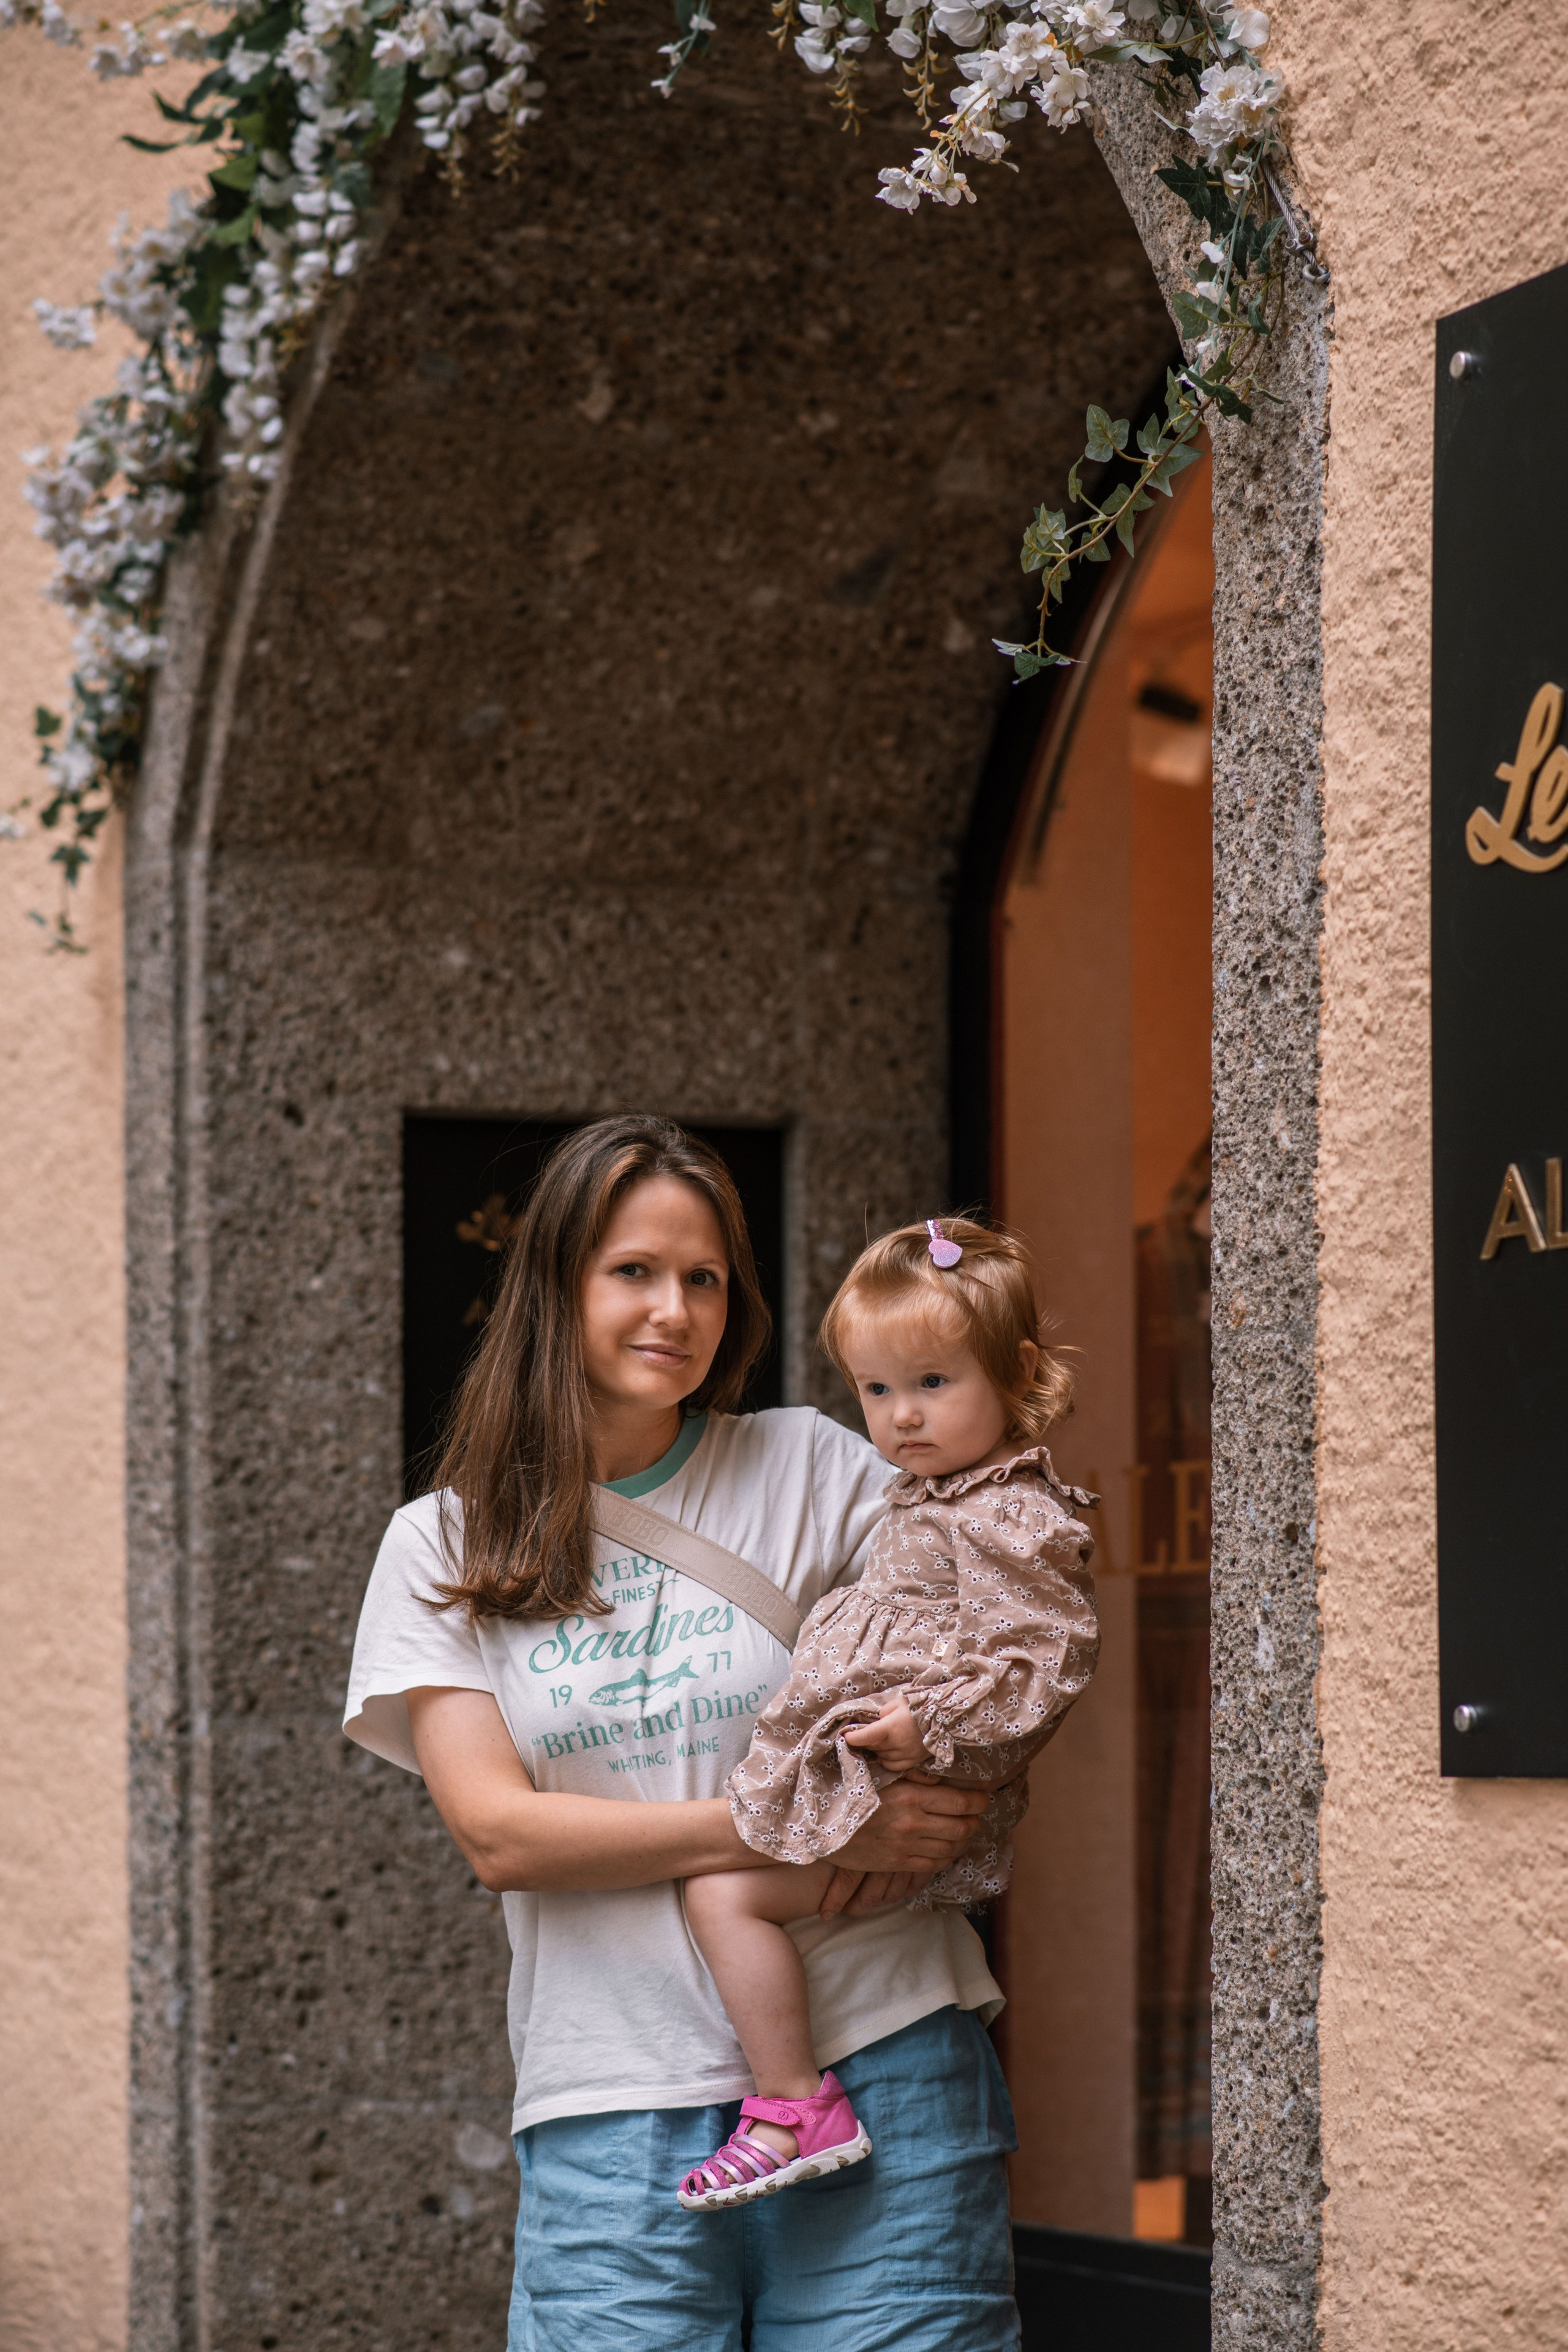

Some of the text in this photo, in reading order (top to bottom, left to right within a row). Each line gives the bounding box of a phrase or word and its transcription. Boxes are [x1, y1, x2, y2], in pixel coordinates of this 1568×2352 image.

[1479, 1156, 1568, 1261] AL
[529, 1603, 734, 1673] Sardines
[549, 1650, 731, 1708] 19 77
[633, 1700, 684, 1740] and
[607, 1736, 720, 1773] WHITING, MAINE
